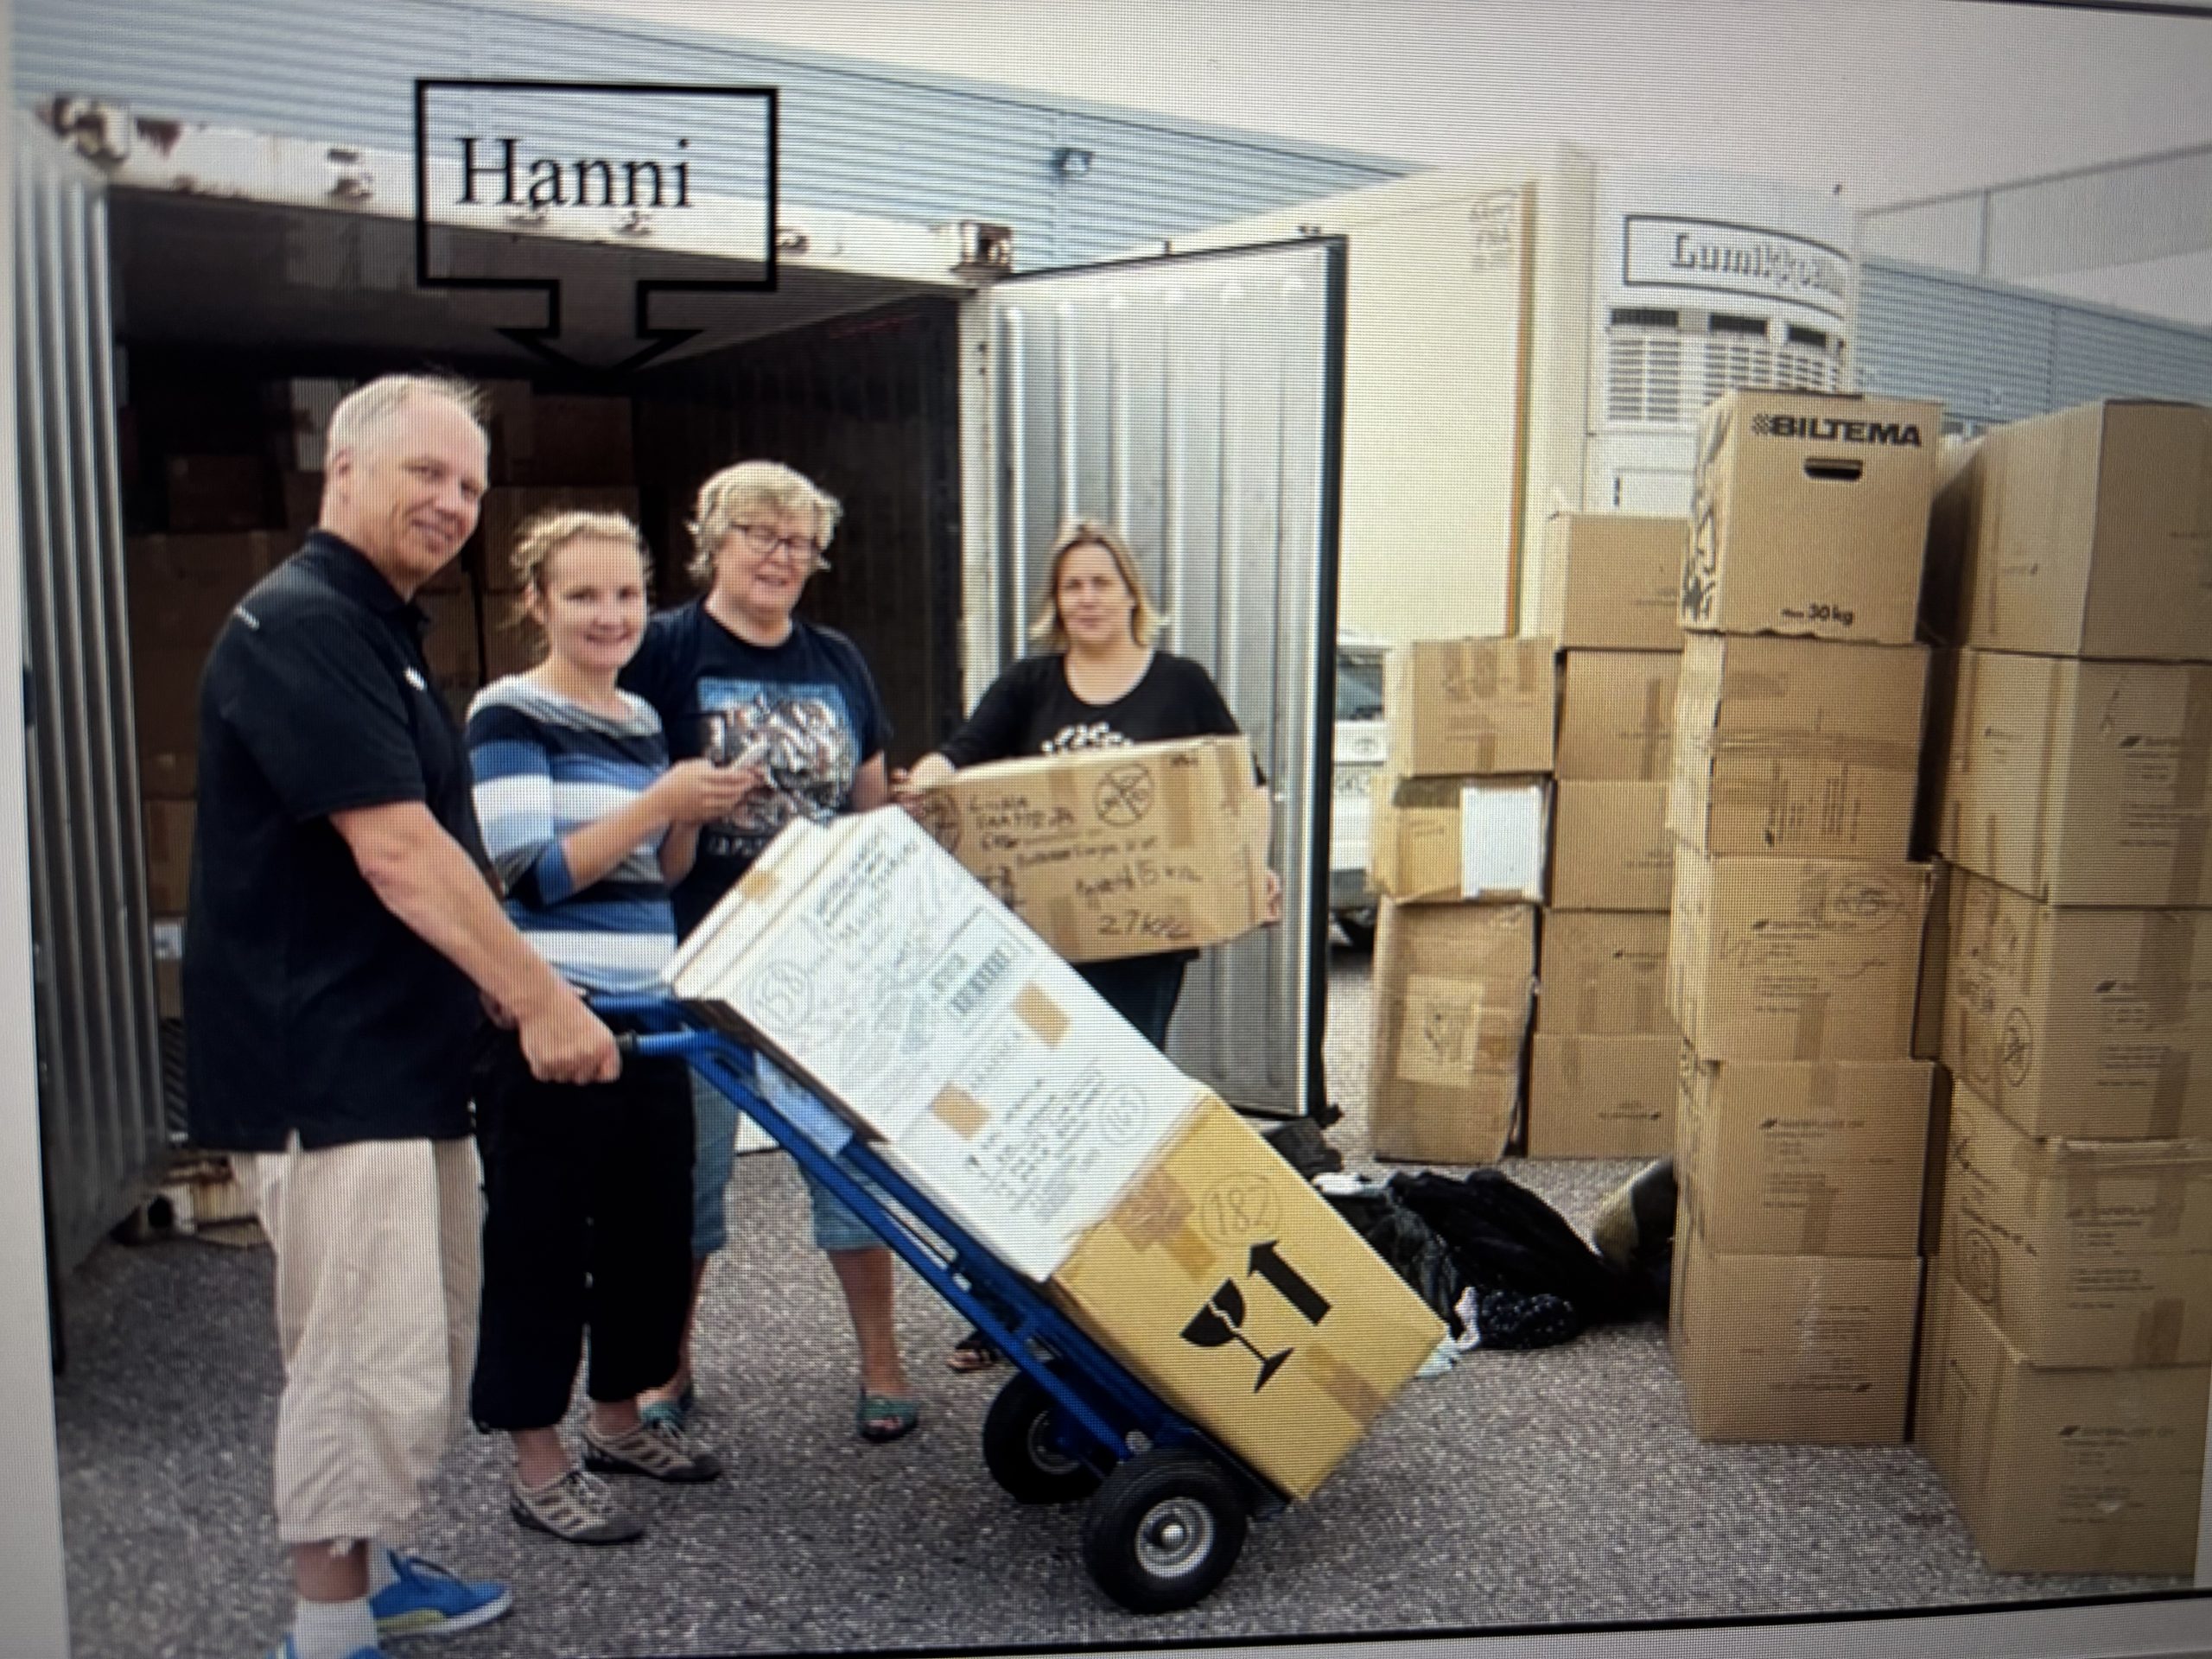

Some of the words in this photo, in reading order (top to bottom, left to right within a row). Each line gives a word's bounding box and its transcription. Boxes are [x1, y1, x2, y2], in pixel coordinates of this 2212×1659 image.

[1770, 415, 1922, 447] BILTEMA
[1807, 602, 1831, 622] 30
[1831, 602, 1857, 628] kg
[1210, 1183, 1271, 1236] 182
